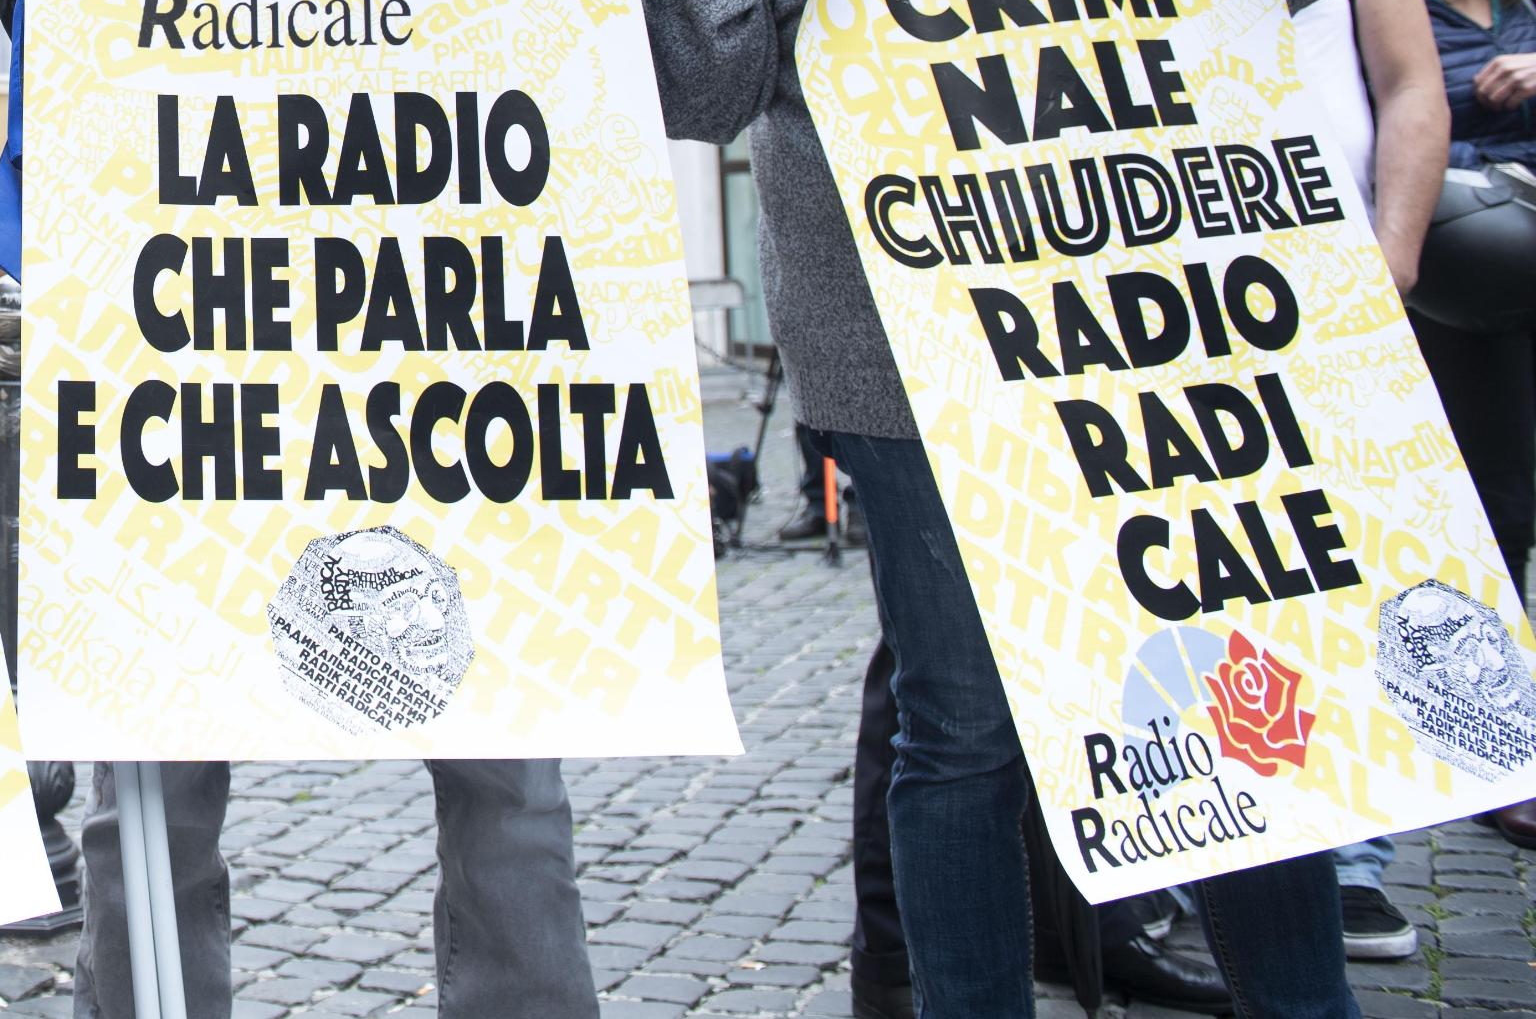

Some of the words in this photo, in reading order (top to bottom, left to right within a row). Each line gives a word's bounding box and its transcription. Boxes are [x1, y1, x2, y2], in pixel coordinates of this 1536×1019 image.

[931, 40, 1198, 150] NALE
[158, 94, 258, 206] LA
[278, 90, 550, 206] RADIO
[865, 135, 1345, 268] CHIUDERE
[133, 234, 293, 353] CHE
[315, 236, 590, 351] PARLA
[969, 255, 1299, 381] RADIO
[57, 381, 96, 499] E
[121, 380, 283, 503] CHE
[304, 381, 675, 503] ASCOLTA
[1055, 373, 1313, 498] RADI
[1117, 489, 1363, 621] CALE
[297, 662, 337, 693] PARTI
[335, 687, 393, 731] RADICAL
[328, 625, 381, 665] PARTITO
[380, 661, 449, 711] RADICALE
[338, 647, 394, 691] RADICAL
[397, 687, 443, 720] PARTY
[1426, 679, 1475, 713] PARTITO
[1478, 706, 1536, 744] RADICALE
[1444, 699, 1496, 734] RADICAL
[1084, 715, 1214, 800] Radio
[1421, 720, 1457, 746] PARTI
[1459, 738, 1515, 773] RADICAL
[1071, 777, 1266, 873] Radicale
